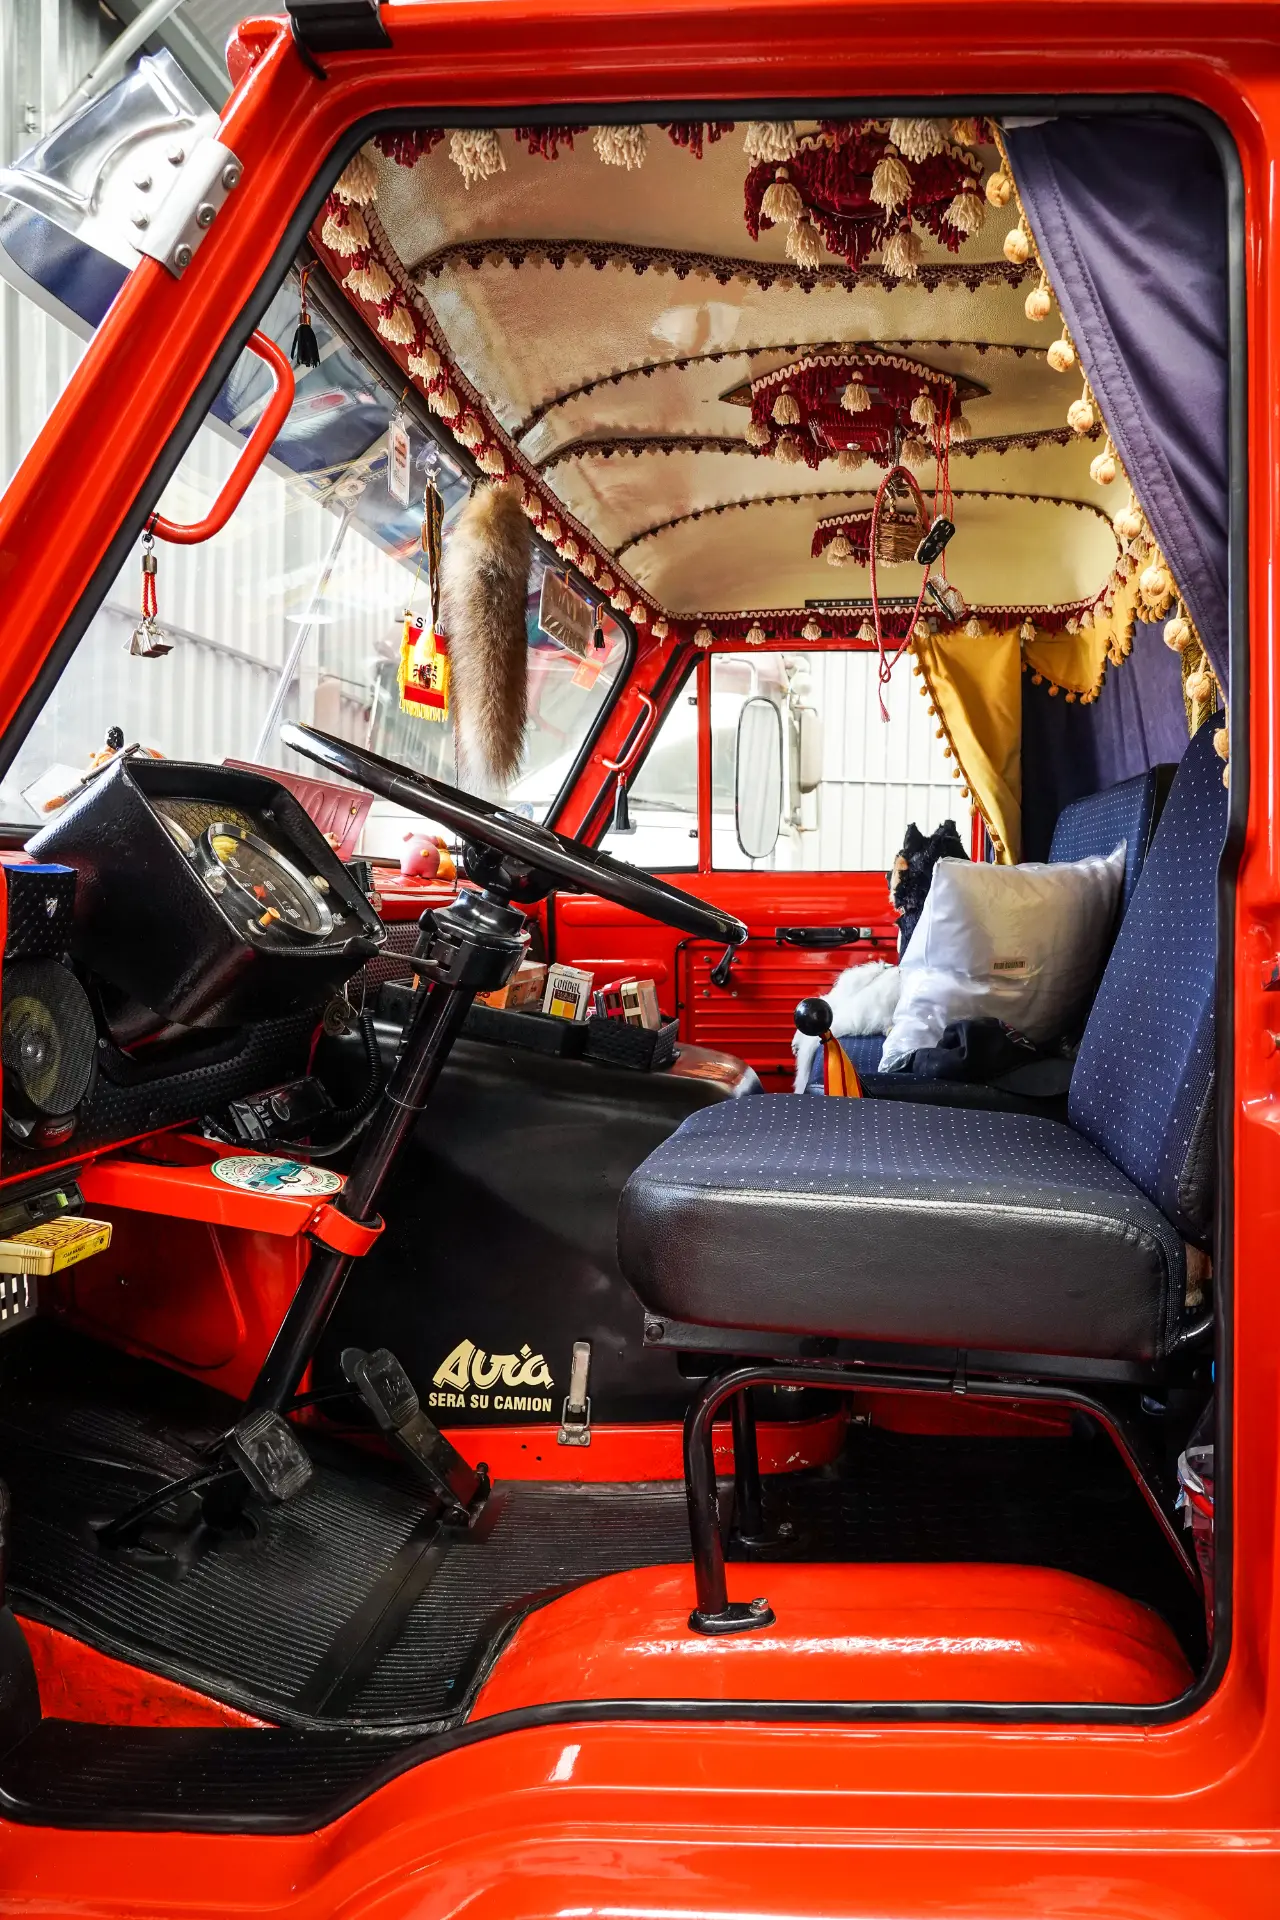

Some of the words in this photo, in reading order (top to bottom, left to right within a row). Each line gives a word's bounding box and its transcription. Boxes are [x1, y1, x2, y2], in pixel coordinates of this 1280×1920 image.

[415, 617, 446, 634] SIN
[428, 1392, 466, 1408] SERA
[470, 1395, 489, 1409] SU
[494, 1396, 552, 1412] CAMION
